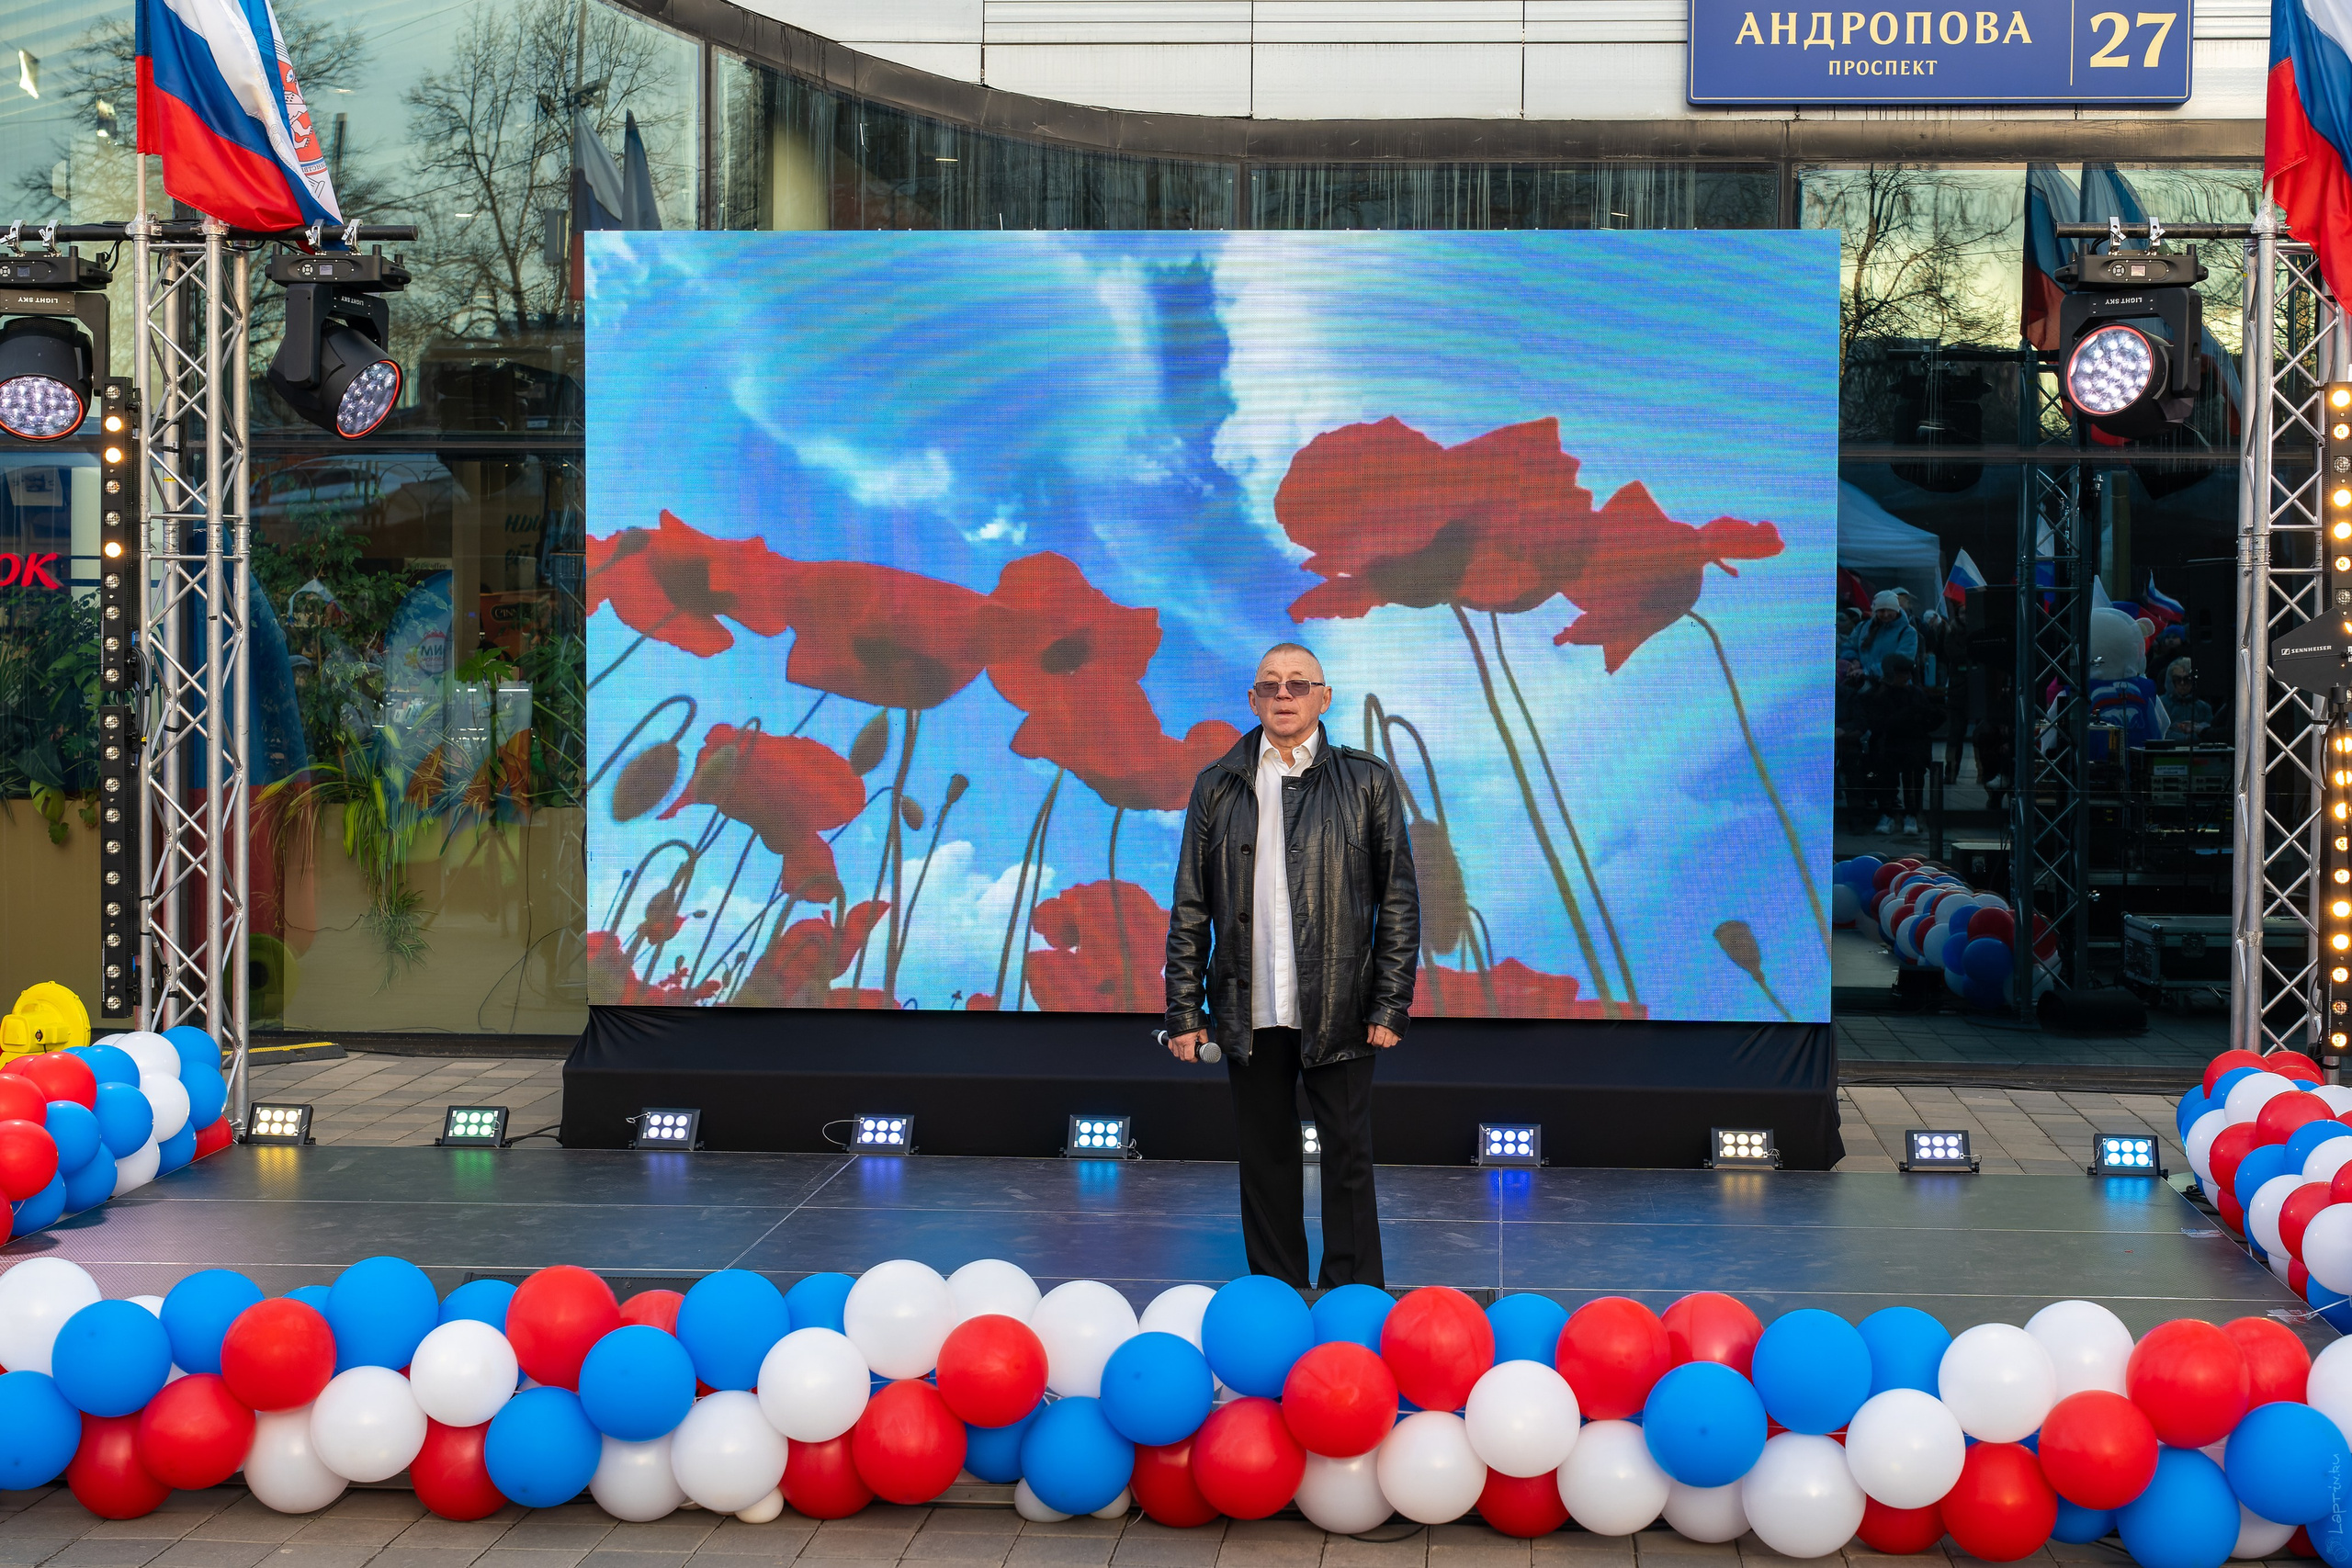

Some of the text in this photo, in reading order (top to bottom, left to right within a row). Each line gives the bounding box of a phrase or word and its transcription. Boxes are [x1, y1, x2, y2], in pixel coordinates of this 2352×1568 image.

[1735, 11, 2177, 67] АНДРОПОВА 27
[1828, 60, 1938, 75] ПРОСПЕКТ
[2290, 645, 2332, 654] SENNHEISER
